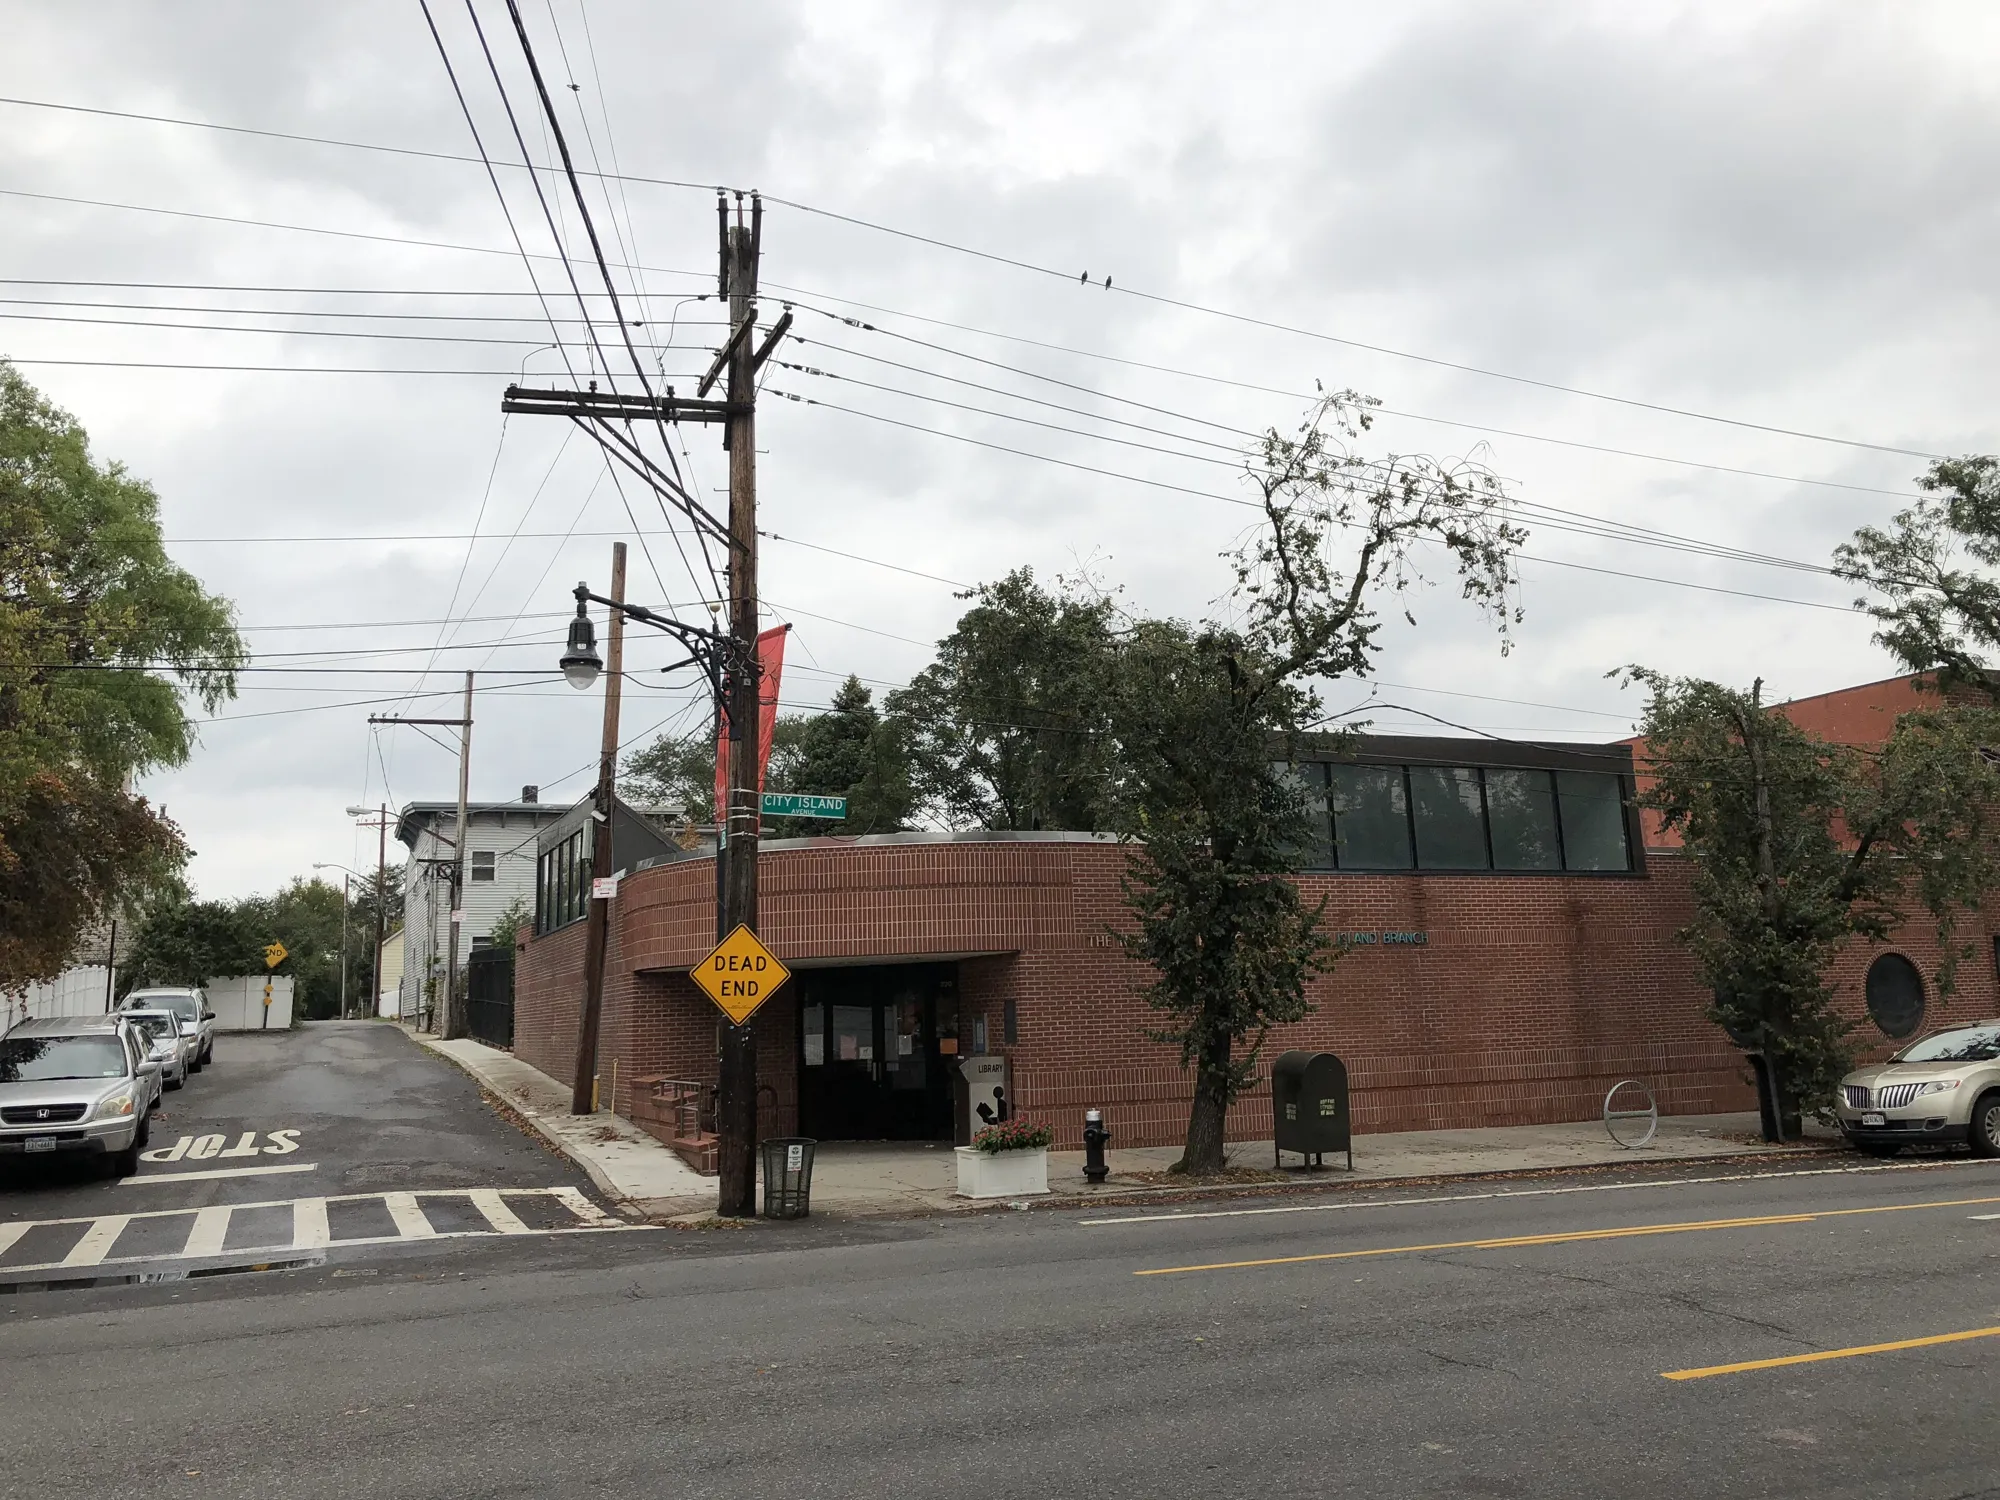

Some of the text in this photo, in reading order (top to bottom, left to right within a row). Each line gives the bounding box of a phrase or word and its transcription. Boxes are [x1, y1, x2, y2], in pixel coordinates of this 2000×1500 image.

[764, 795, 843, 810] CITY ISLAND
[791, 808, 816, 816] AVENUE
[1089, 934, 1112, 948] THE
[1383, 931, 1429, 944] BRANCH
[714, 955, 767, 972] DEAD
[721, 980, 759, 997] END
[978, 1064, 1003, 1074] LIBRARY
[139, 1129, 301, 1162] STOP
